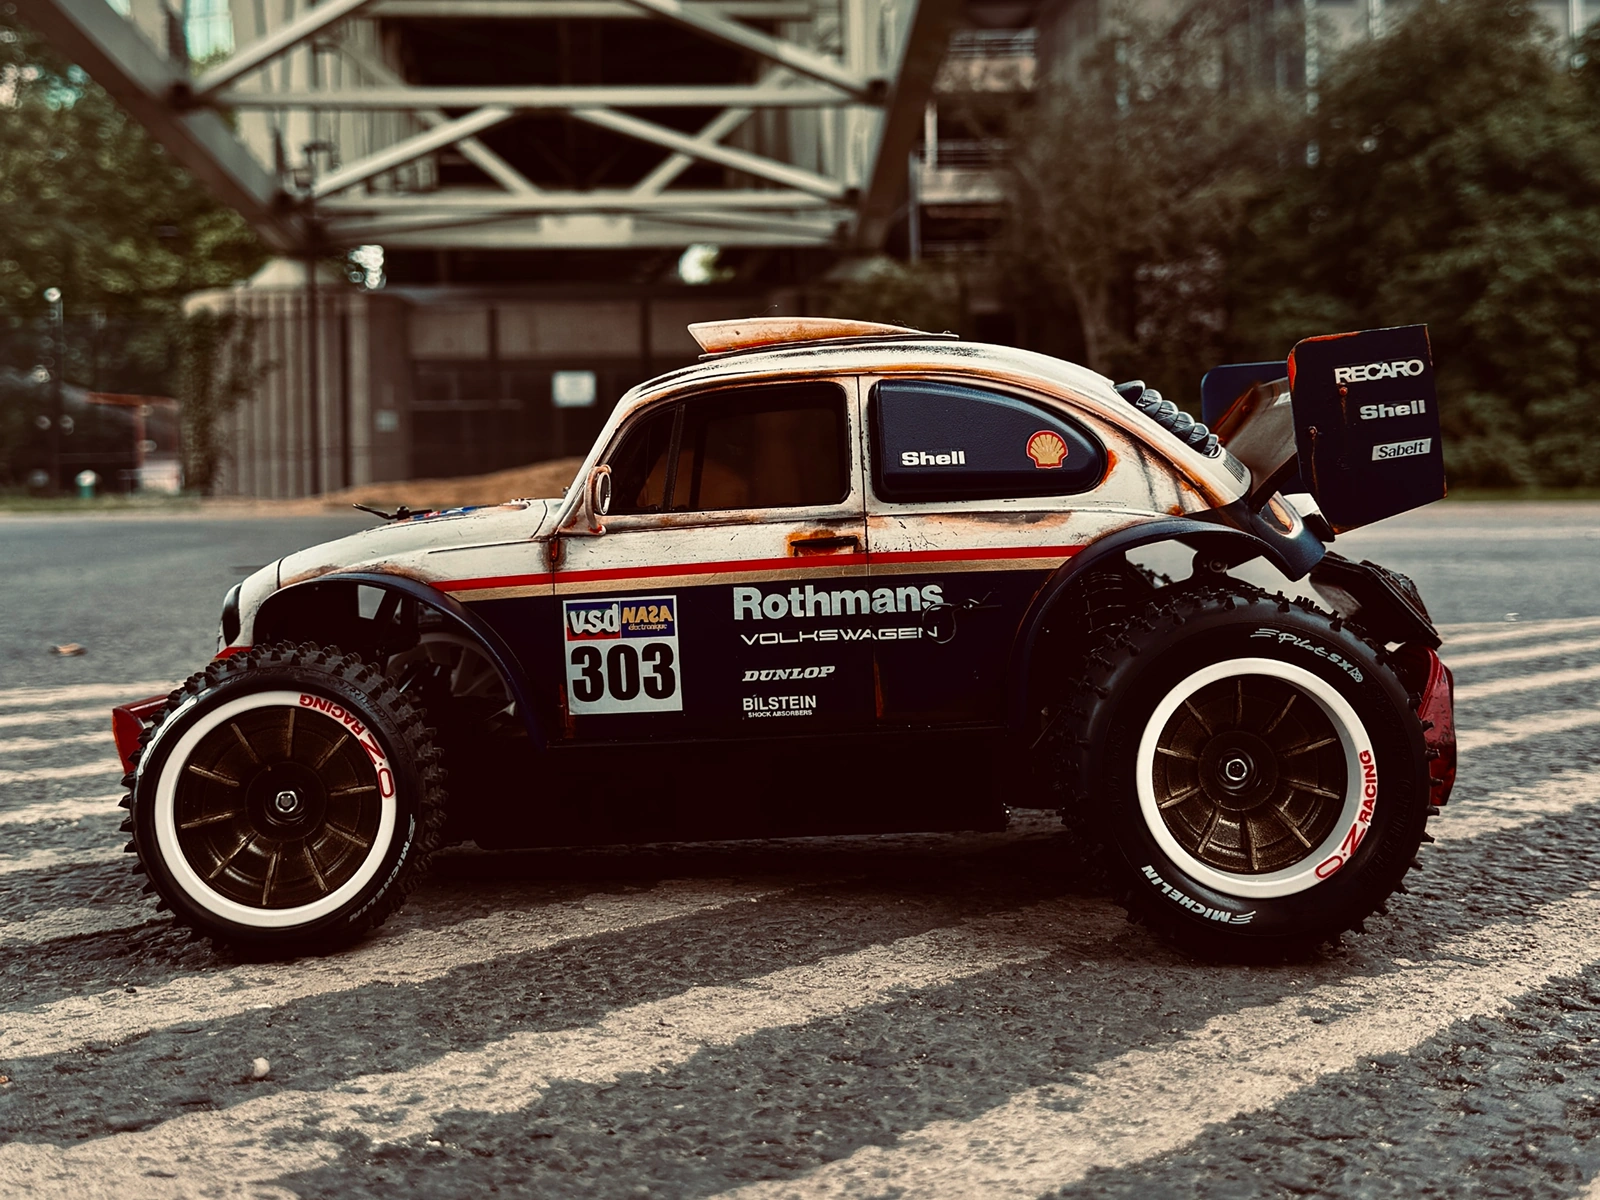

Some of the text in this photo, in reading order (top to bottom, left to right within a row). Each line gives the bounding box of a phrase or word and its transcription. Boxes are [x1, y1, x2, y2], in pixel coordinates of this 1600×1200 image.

[1334, 359, 1424, 384] RECARO
[1359, 400, 1426, 420] Shell
[902, 451, 966, 467] Shell
[1378, 441, 1424, 459] Sabelt
[733, 584, 946, 621] Rothmans
[569, 603, 620, 634] vsd
[741, 626, 938, 646] VOLKSWAGEN
[570, 642, 676, 703] 303
[742, 665, 836, 682] DUNLOP
[742, 695, 817, 711] BILSTEIN
[772, 709, 813, 717] ABSORBERS
[300, 694, 366, 736] RACING
[1358, 749, 1377, 823] RACING
[1141, 865, 1232, 923] MICHELIN
